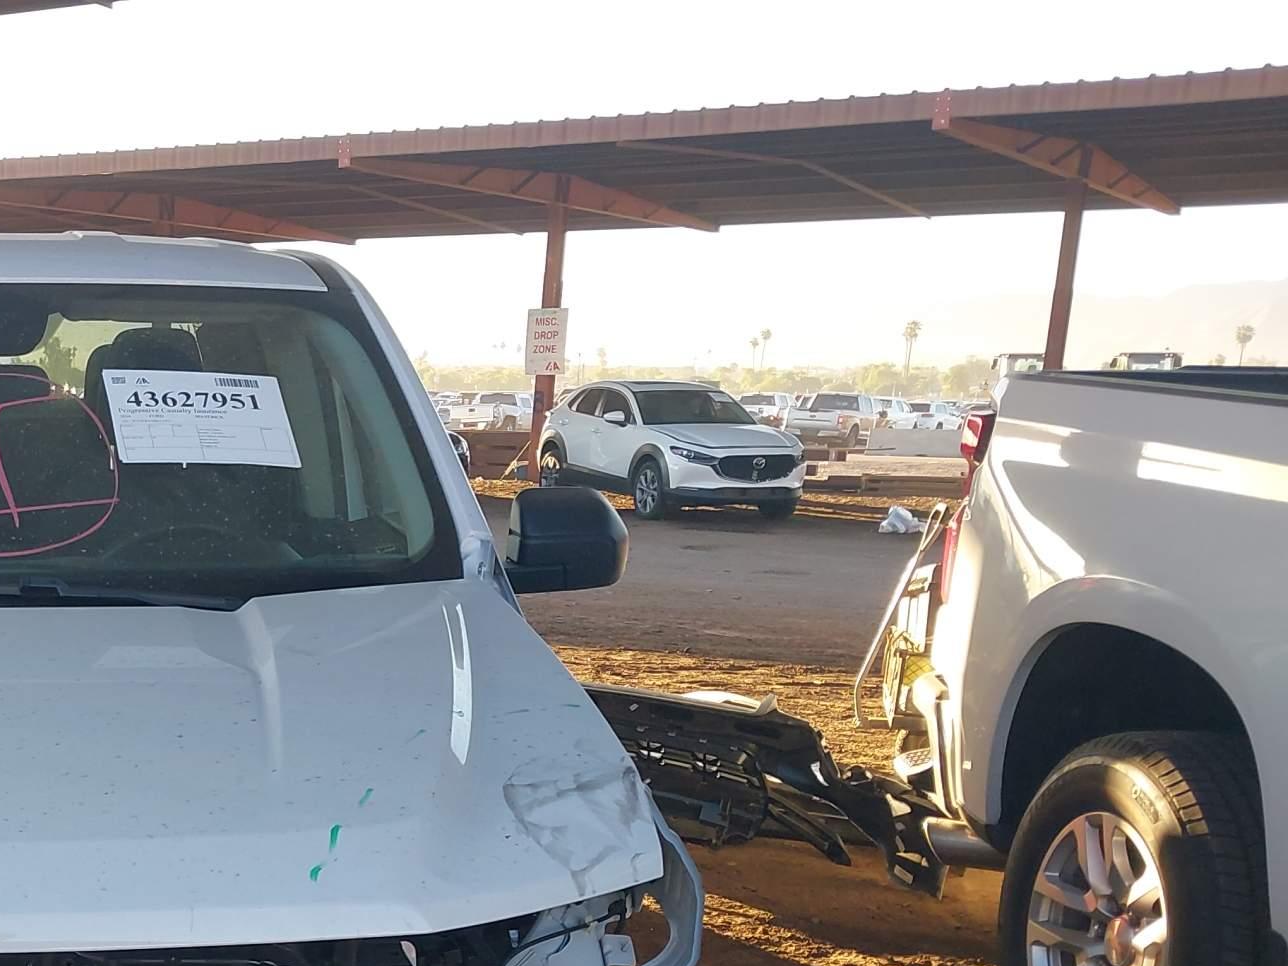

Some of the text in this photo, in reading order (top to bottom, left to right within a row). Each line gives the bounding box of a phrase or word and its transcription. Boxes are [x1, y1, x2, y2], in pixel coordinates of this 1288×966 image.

[535, 317, 560, 327] MISC.
[534, 330, 559, 340] DROP
[532, 344, 558, 354] ZONE
[126, 390, 263, 410] 43627951
